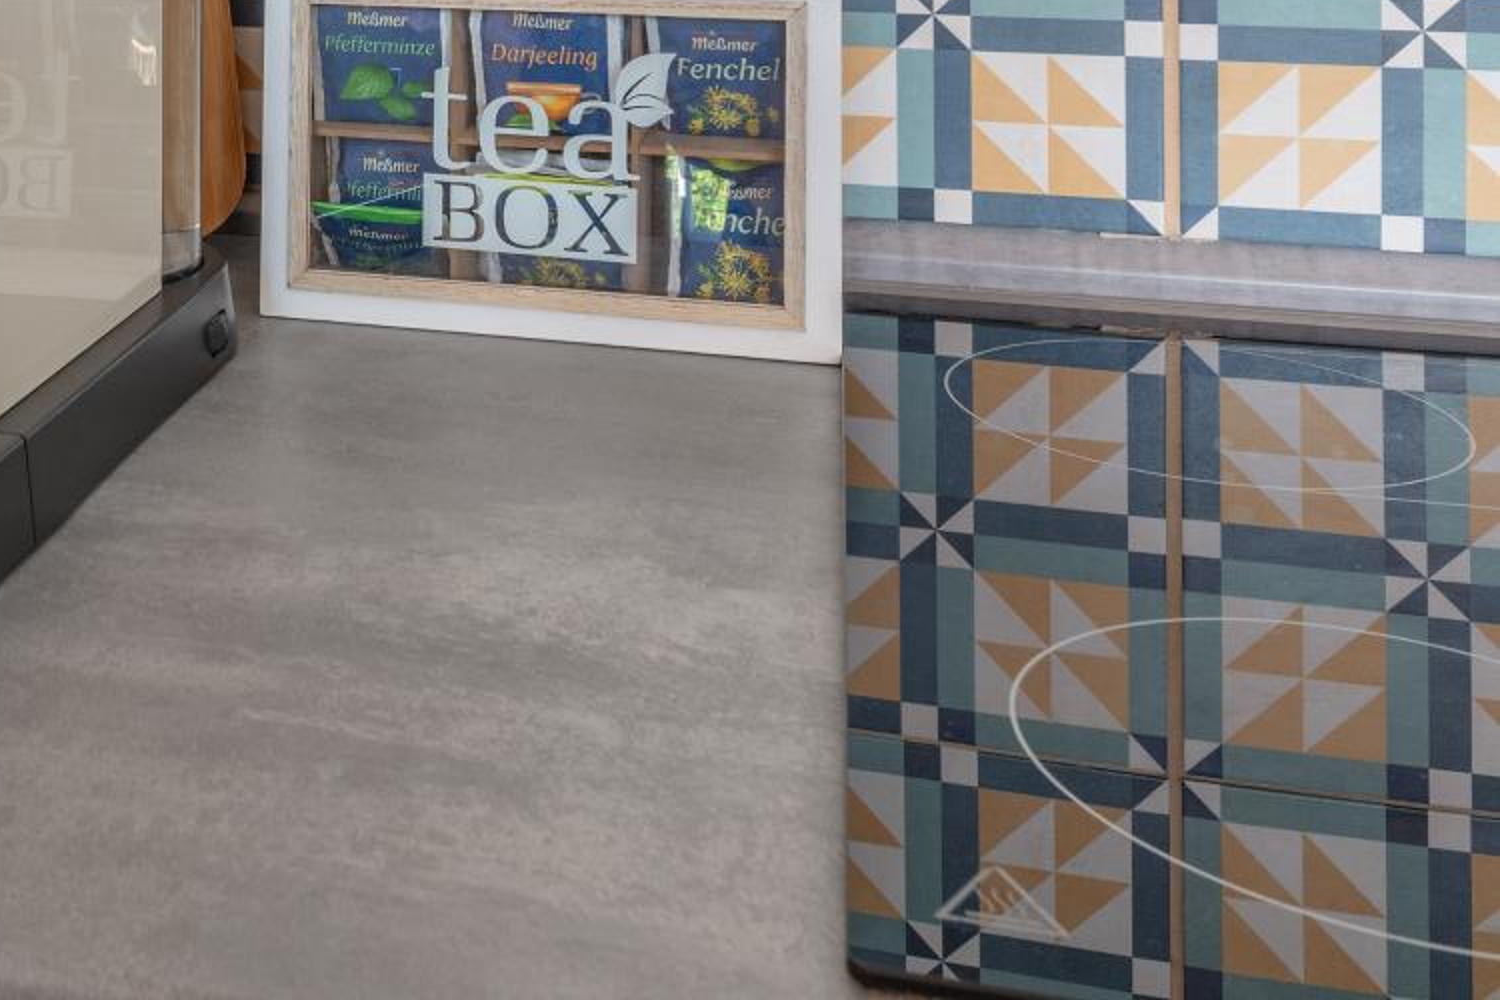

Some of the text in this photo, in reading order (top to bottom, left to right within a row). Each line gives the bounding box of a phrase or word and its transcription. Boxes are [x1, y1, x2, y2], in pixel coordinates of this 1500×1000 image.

[346, 10, 407, 28] Meßmer
[325, 34, 436, 57] Pfefferminze
[492, 43, 597, 72] Darjeeling
[692, 36, 758, 53] Meßmer
[677, 57, 781, 83] Fenchel
[421, 66, 640, 181] tea
[433, 179, 629, 256] BOX
